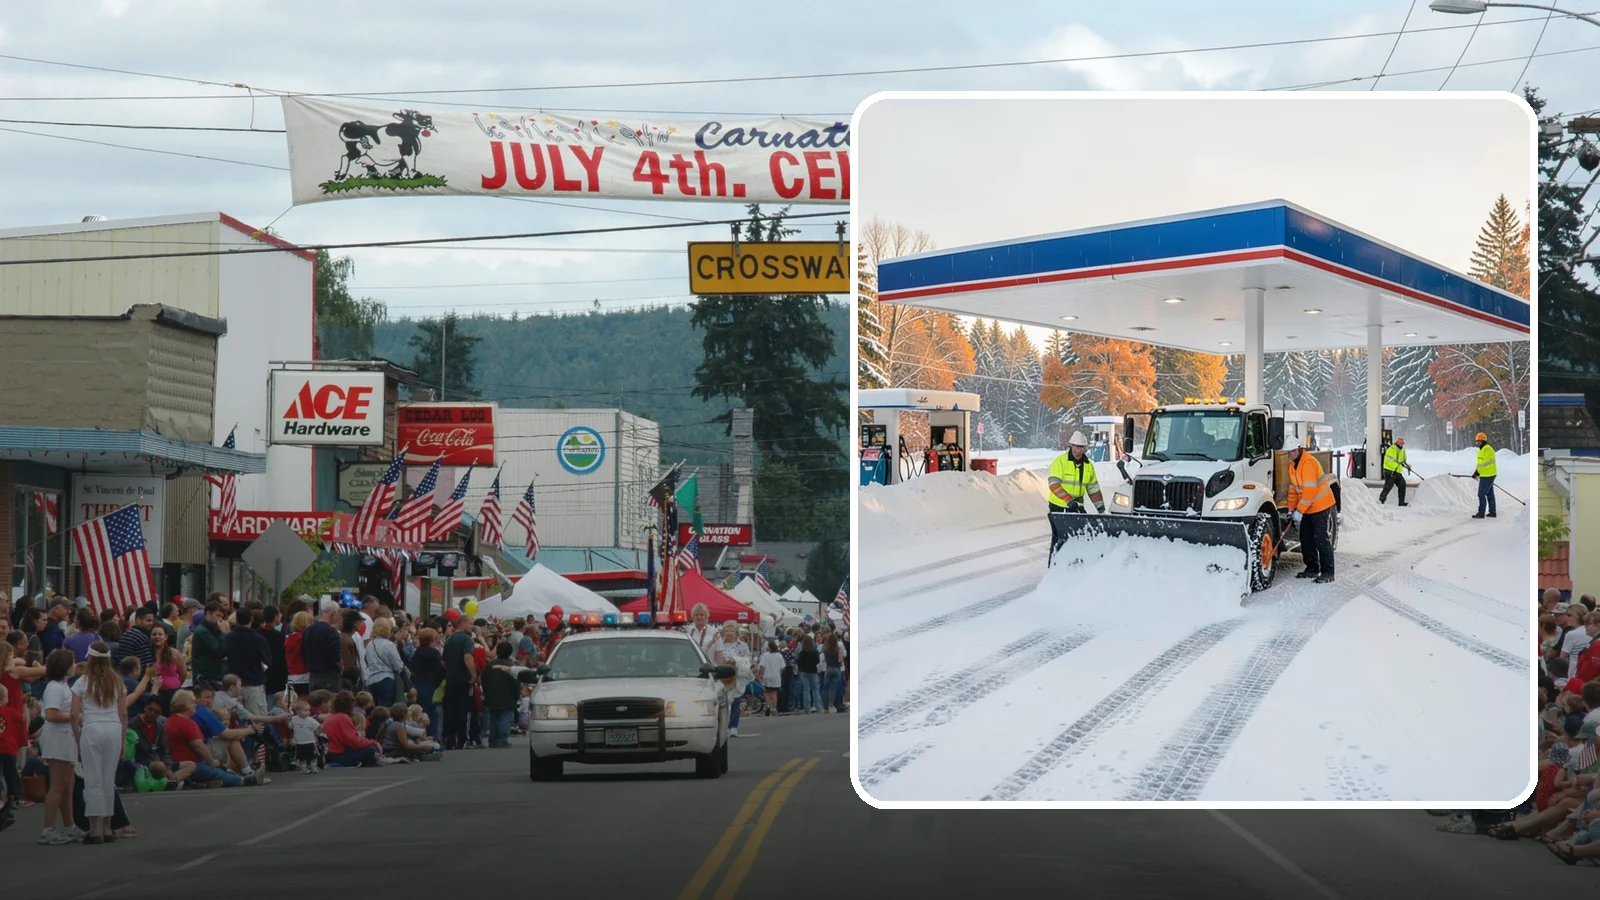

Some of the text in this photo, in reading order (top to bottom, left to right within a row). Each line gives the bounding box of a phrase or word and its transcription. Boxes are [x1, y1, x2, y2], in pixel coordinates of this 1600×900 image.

[695, 121, 850, 150] Carnat
[481, 141, 605, 193] JULY
[632, 150, 746, 198] 4th.
[696, 254, 850, 280] CROSSWA
[282, 380, 373, 420] ACE
[283, 421, 371, 436] Hardware
[416, 427, 477, 447] Coca-Cola
[353, 466, 385, 479] Simpl
[95, 485, 124, 494] Vincent
[126, 485, 136, 494] de
[137, 485, 155, 495] Paul
[213, 515, 331, 535] HARDARE
[687, 526, 741, 535] CRNATION
[698, 535, 731, 543] GLASS
